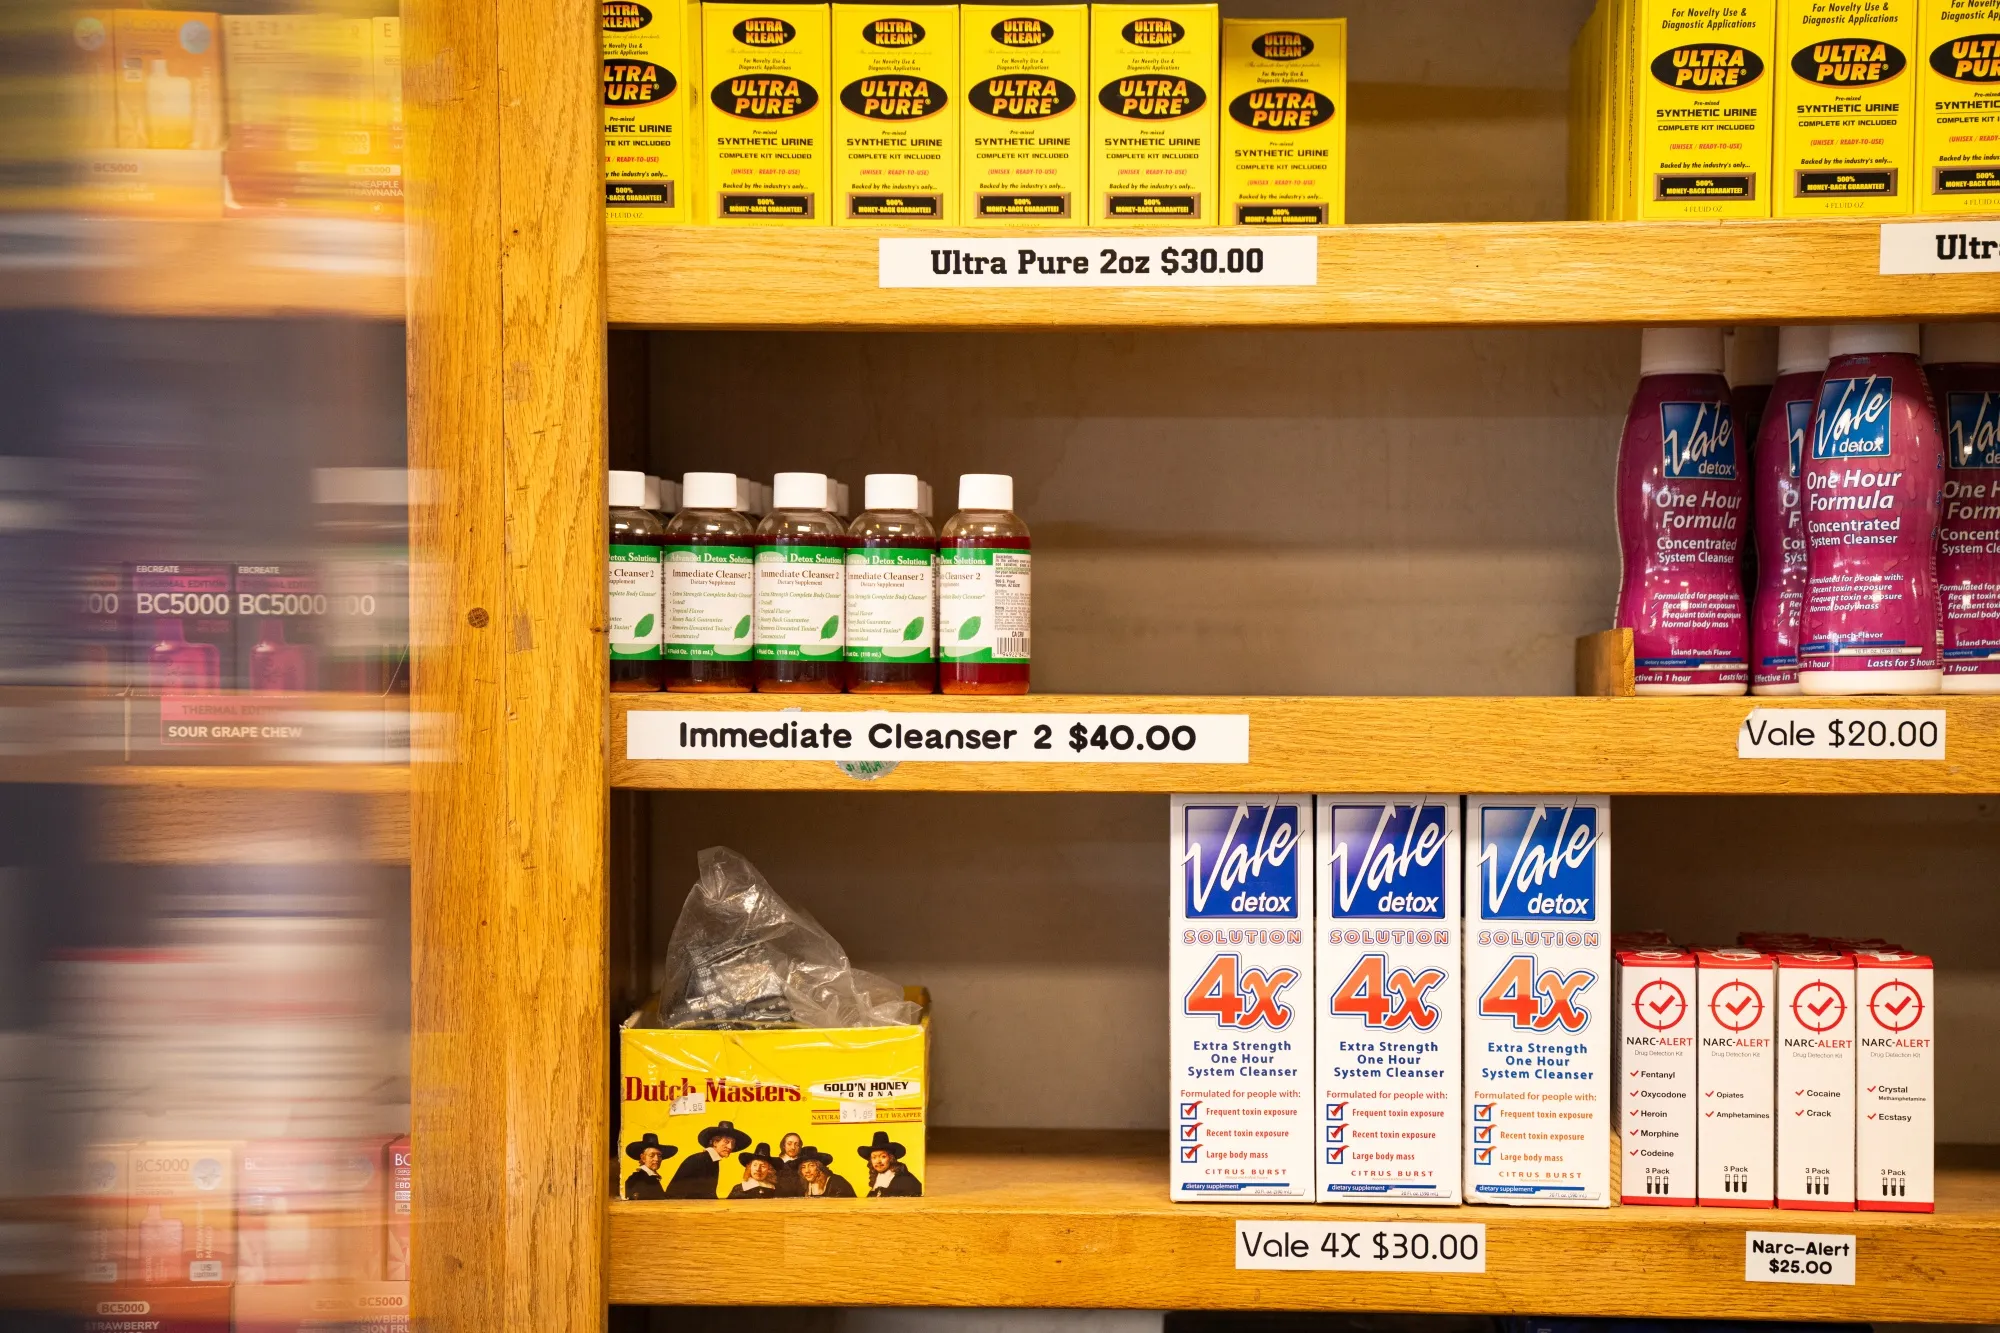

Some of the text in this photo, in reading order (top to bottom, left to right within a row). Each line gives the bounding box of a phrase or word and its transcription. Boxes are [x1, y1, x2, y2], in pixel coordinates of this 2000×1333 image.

[1671, 8, 1747, 19] For Novelty Use &
[1134, 21, 1172, 33] ULTRA
[1661, 19, 1756, 31] Diagnostic Applications
[1672, 50, 1745, 68] ULTRA
[1813, 44, 1887, 63] ULTRA
[731, 80, 800, 98] ULTRA
[860, 81, 930, 99] ULTRA
[989, 79, 1057, 97] ULTRA
[1119, 80, 1187, 97] ULTRA
[1249, 91, 1316, 110] ULTRA
[1656, 109, 1757, 117] SYNTHETIC URINE
[1797, 103, 1900, 114] SYNTHETIC URINE
[639, 124, 673, 133] URINE
[1105, 138, 1200, 146] SYNTHETIC URINE
[931, 246, 1263, 276] Ultra Pure 2oz $30.00
[1815, 374, 1892, 455] Vale
[1839, 437, 1884, 453] detox
[1806, 469, 1902, 490] One Hour
[1810, 490, 1894, 511] Formula
[1808, 517, 1900, 533] Concentrated
[1811, 534, 1898, 548] System Cleanser
[703, 553, 728, 563] Detox
[872, 555, 928, 566] Detox Solutions
[136, 565, 180, 574] EBCREATE
[238, 566, 280, 575] EBCREATE
[672, 569, 747, 579] Immediate Cleanser
[883, 572, 925, 581] Cleanser 2
[709, 579, 736, 587] Supplement
[137, 593, 230, 615] BC5000
[238, 593, 327, 615] BC5000
[1867, 658, 1936, 668] Lasts for 5 hours
[168, 726, 302, 739] SOUR GRAPE CHEW
[680, 721, 1196, 753] Immediate Cleanser 2 $40.00
[1745, 719, 1938, 749] Vale $20.00
[1181, 796, 1305, 912] Vale
[1327, 795, 1453, 913] Vale
[1477, 796, 1603, 914] Vale
[1231, 891, 1292, 913] detox
[1378, 891, 1439, 914] detox
[1527, 893, 1588, 915] detox
[1182, 928, 1304, 946] SOLUTION
[1329, 929, 1451, 947] SOLUTION
[1478, 931, 1600, 948] SOLUTION
[1194, 1041, 1292, 1053] Extra Strength
[1626, 1037, 1693, 1046] NARC-ALERT
[1703, 1038, 1770, 1047] NARC-ALERT
[1784, 1038, 1853, 1049] NARC-ALERT
[1861, 1038, 1931, 1048] NARC-ALERT
[1211, 1054, 1274, 1064] One Hour
[1188, 1066, 1298, 1079] System Cleanser
[1640, 1070, 1676, 1079] Fentanyl
[625, 1076, 696, 1102] Dutch
[823, 1081, 909, 1092] GOLD'N HONEY
[1878, 1085, 1908, 1094] Crystal
[1180, 1090, 1301, 1099] Formulated for people with:
[1640, 1090, 1687, 1099] Oxycodone
[1716, 1091, 1744, 1099] Opiates
[1806, 1090, 1841, 1098] Cocaine
[891, 1112, 921, 1120] WRAPPER
[1206, 1108, 1298, 1117] Frequent toxin exposure
[1640, 1110, 1668, 1118] Heroin
[1716, 1111, 1770, 1119] Amphetamines
[1806, 1109, 1832, 1117] Crack
[1878, 1113, 1912, 1122] Ecstasy
[1206, 1129, 1289, 1139] Recent toxin exposure
[1640, 1129, 1679, 1138] Morphine
[1206, 1151, 1228, 1160] Large
[1230, 1151, 1248, 1160] body
[1640, 1149, 1675, 1157] Codeine
[1242, 1231, 1479, 1261] Vale 4X $30.00
[1768, 1259, 1832, 1275] $25.00
[101, 1304, 145, 1313] BC5000
